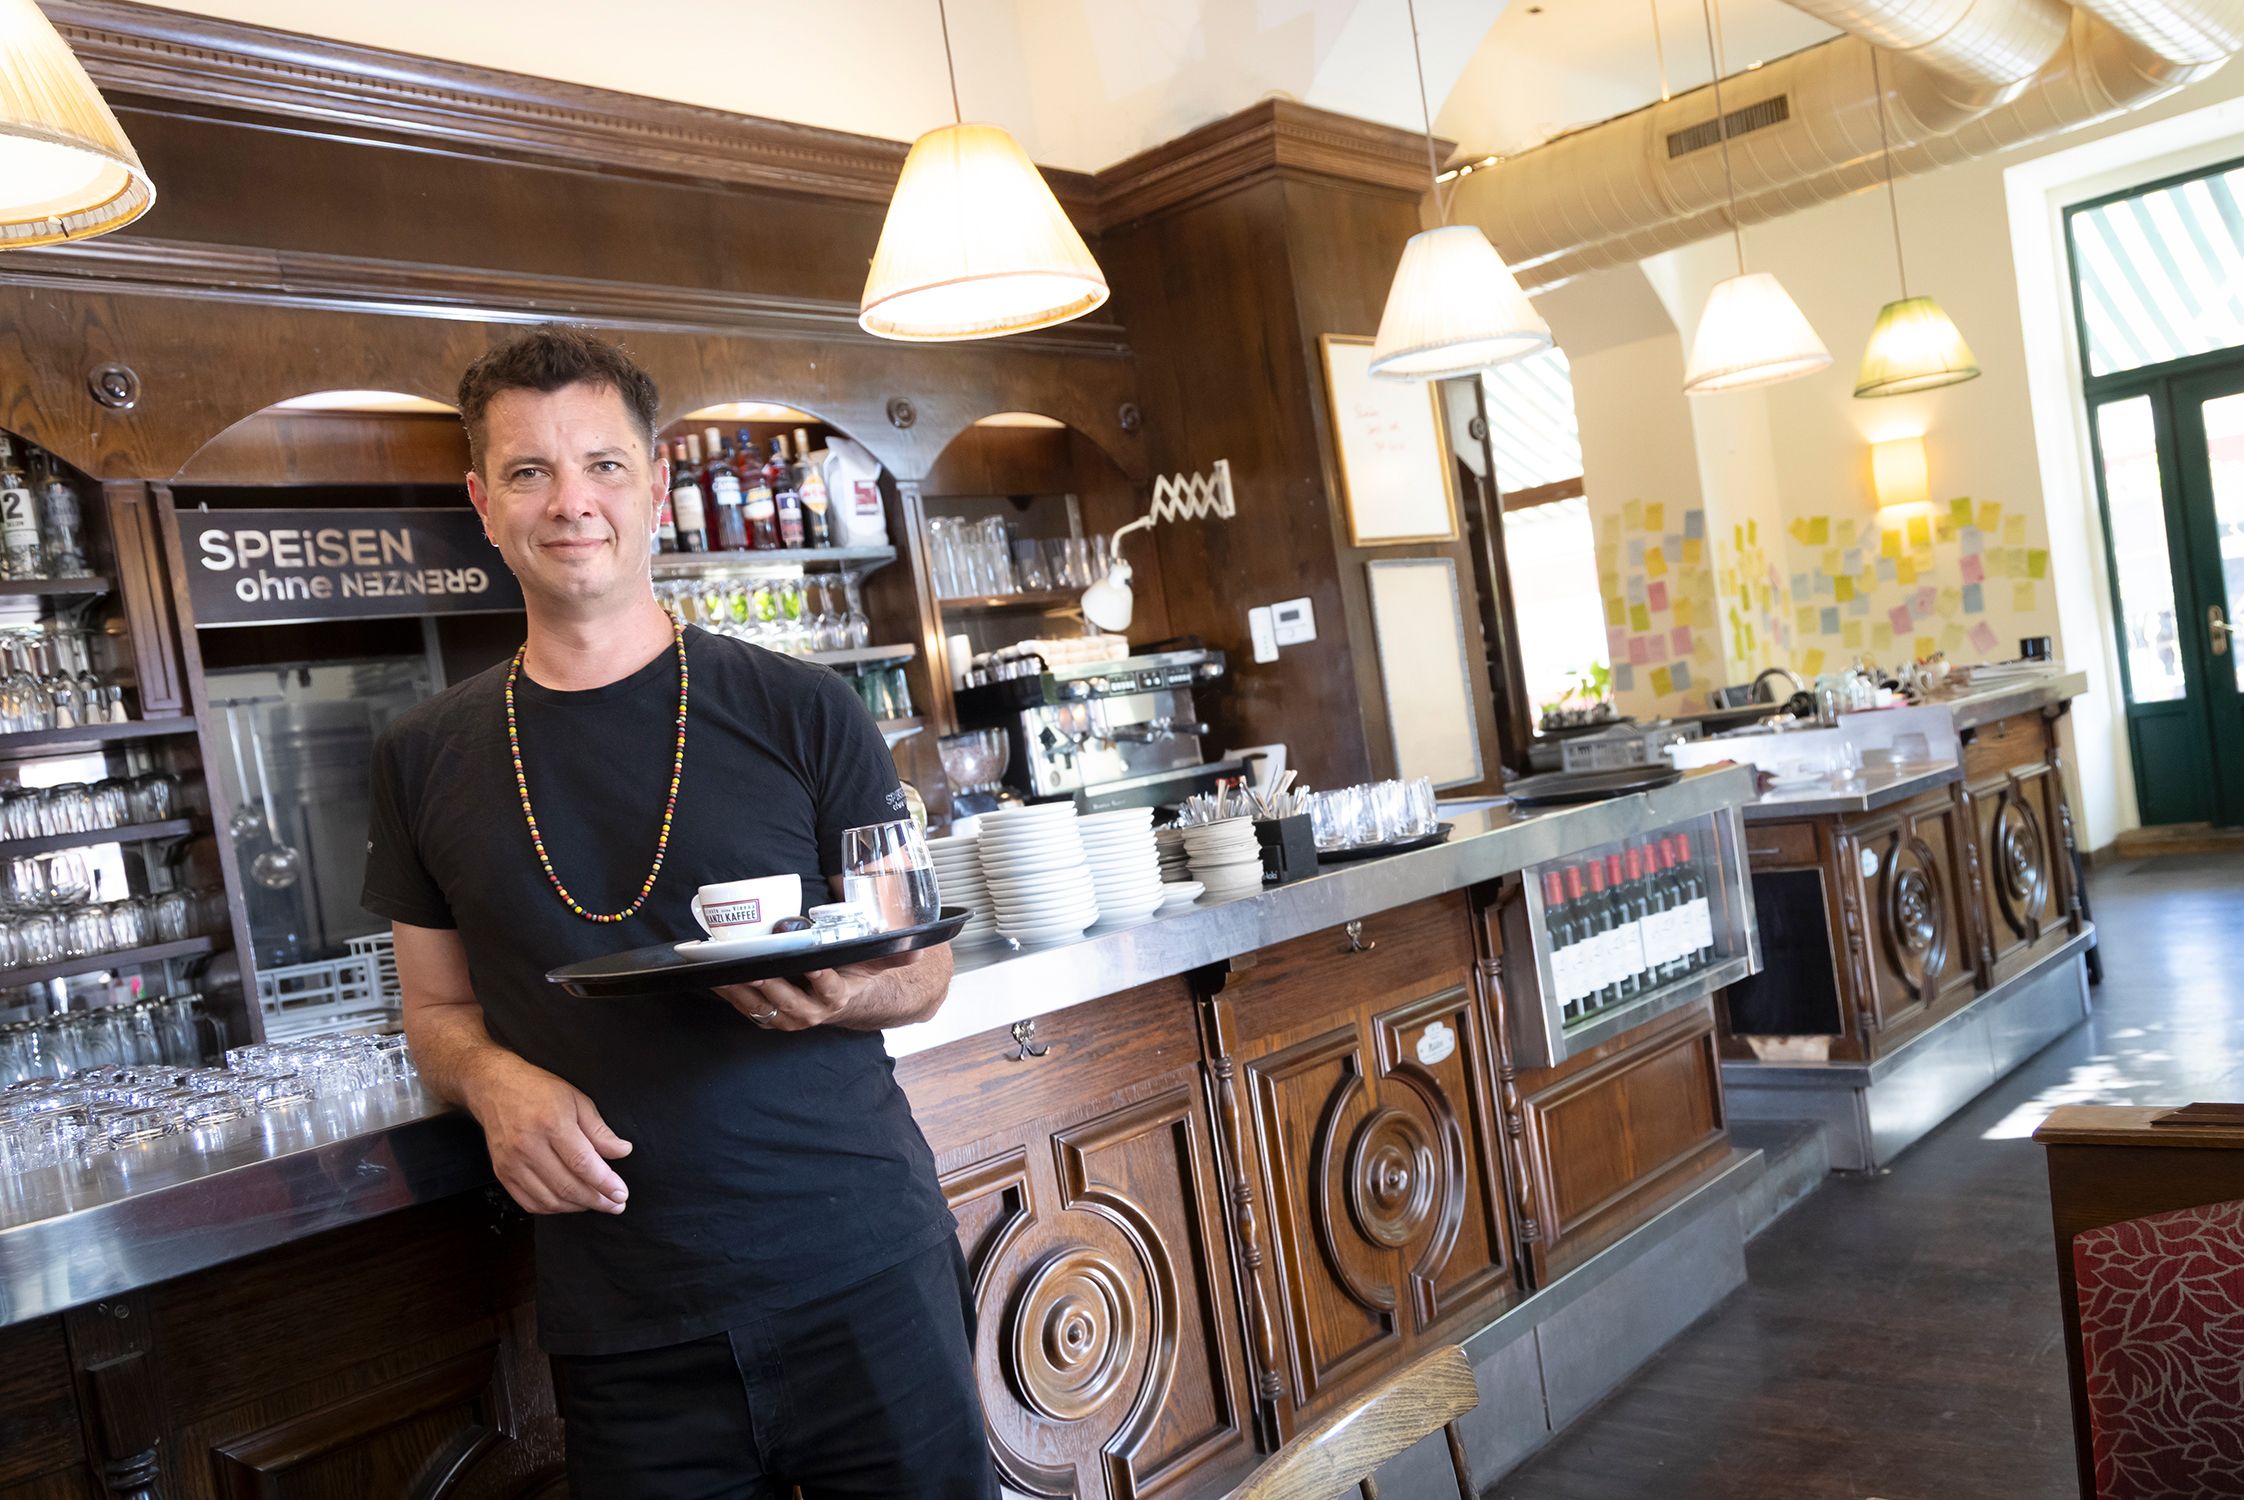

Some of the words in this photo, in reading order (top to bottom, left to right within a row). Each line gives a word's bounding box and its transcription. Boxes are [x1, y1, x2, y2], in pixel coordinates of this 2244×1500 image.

[3, 492, 23, 519] 2
[235, 569, 332, 602] ohne
[340, 567, 489, 598] GRENZEN
[725, 910, 756, 922] KAFFEE
